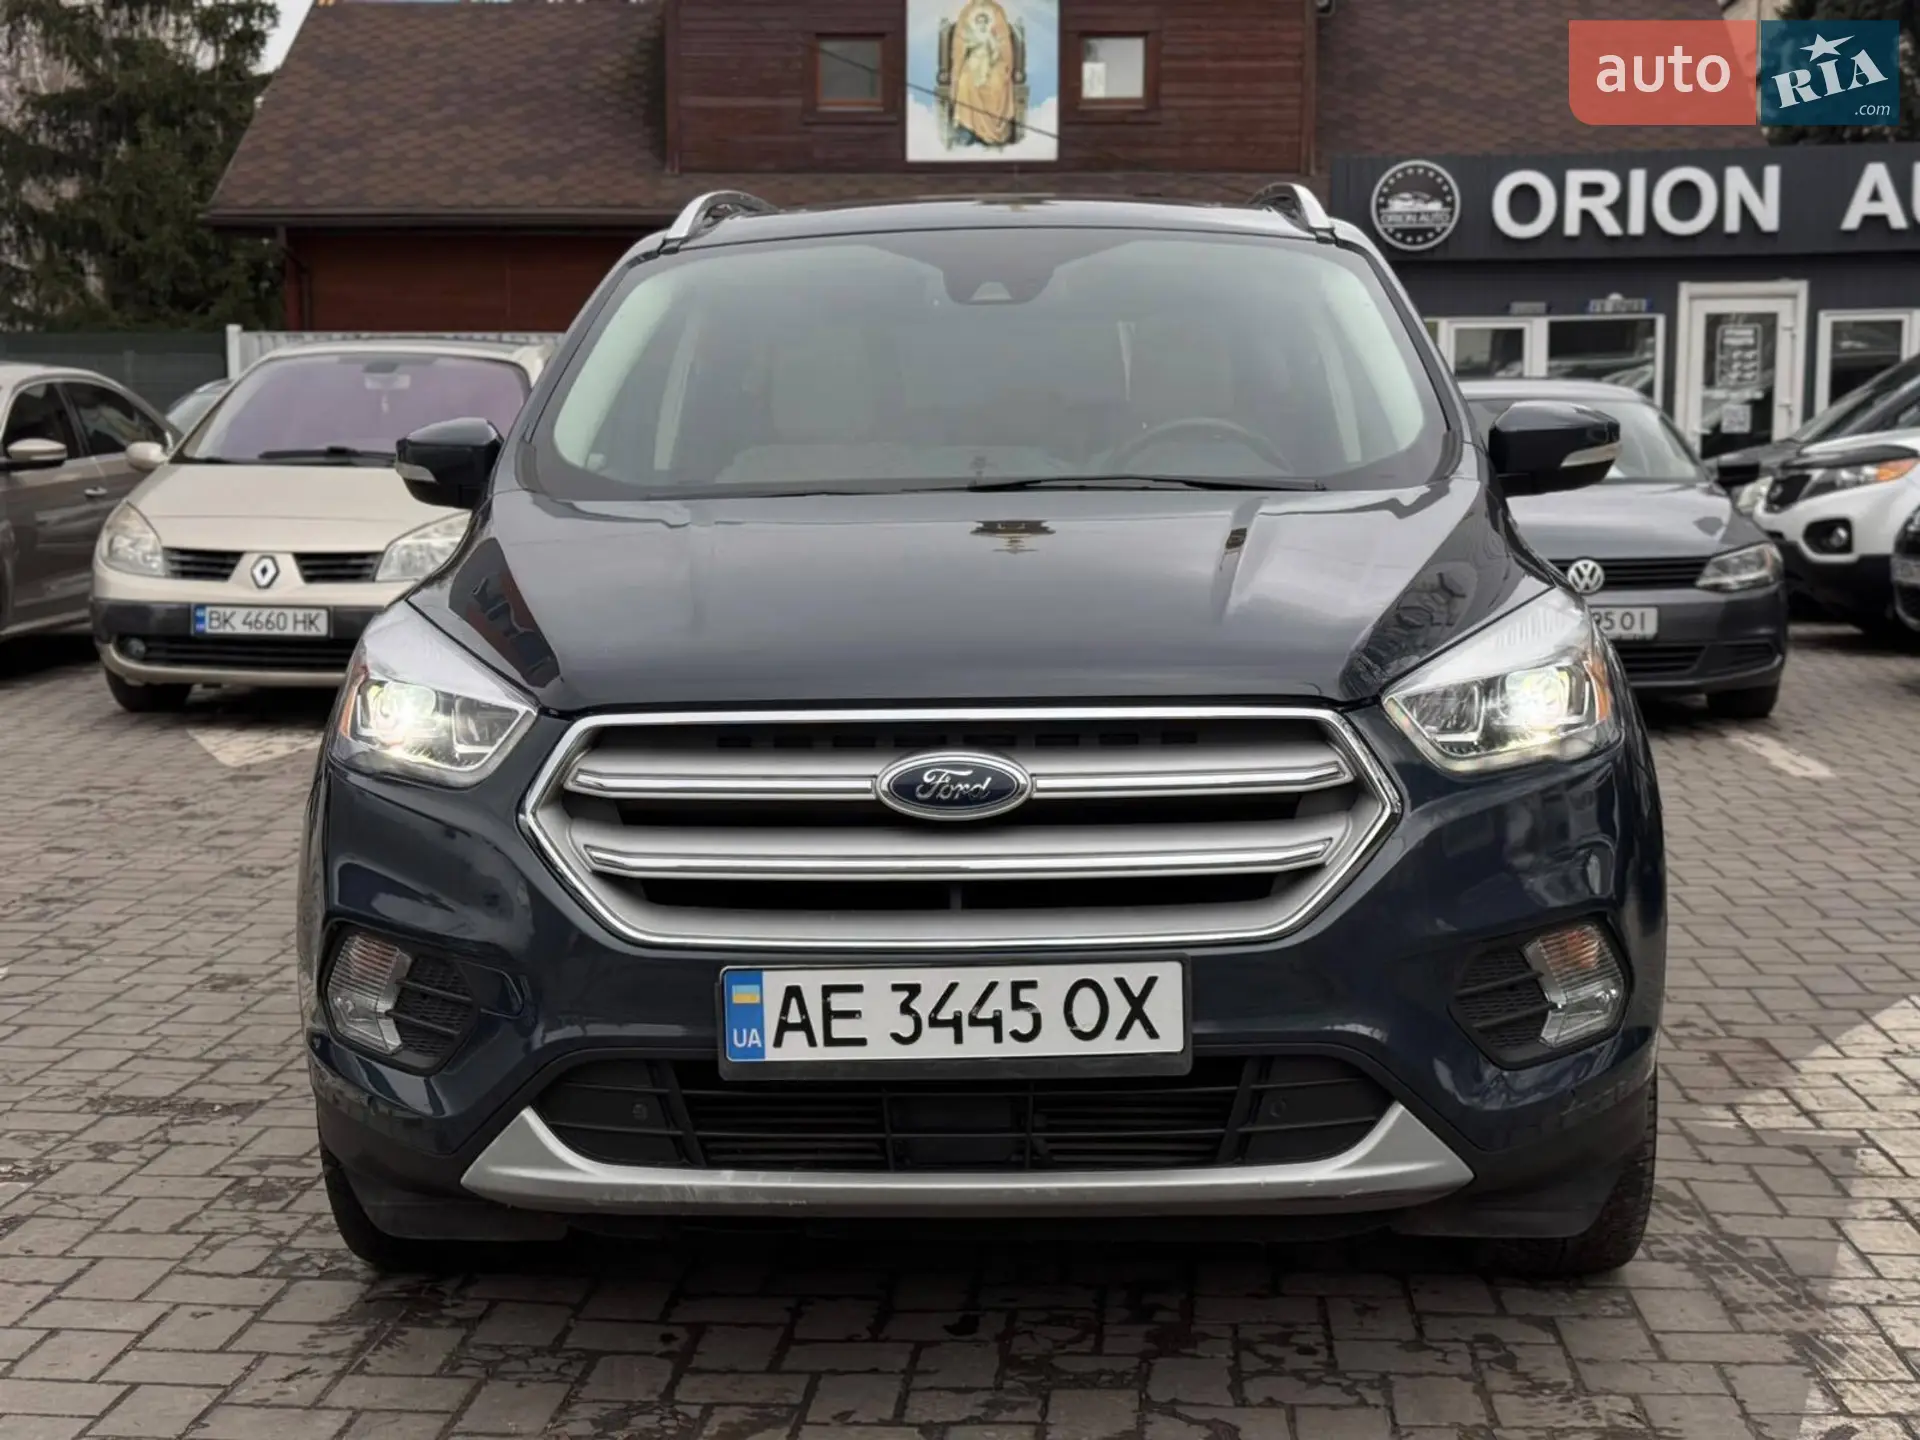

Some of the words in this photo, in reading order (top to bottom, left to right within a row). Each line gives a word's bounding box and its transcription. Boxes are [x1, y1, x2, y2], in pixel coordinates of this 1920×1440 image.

[1491, 164, 1782, 239] ORION
[1840, 161, 1920, 231] A
[208, 609, 237, 631] BK
[241, 610, 288, 632] 4660
[292, 611, 321, 633] HK
[915, 768, 992, 800] Ford
[772, 983, 868, 1048] AE
[889, 980, 1042, 1046] 3445
[1063, 974, 1161, 1042] OX
[733, 1027, 763, 1048] UA
